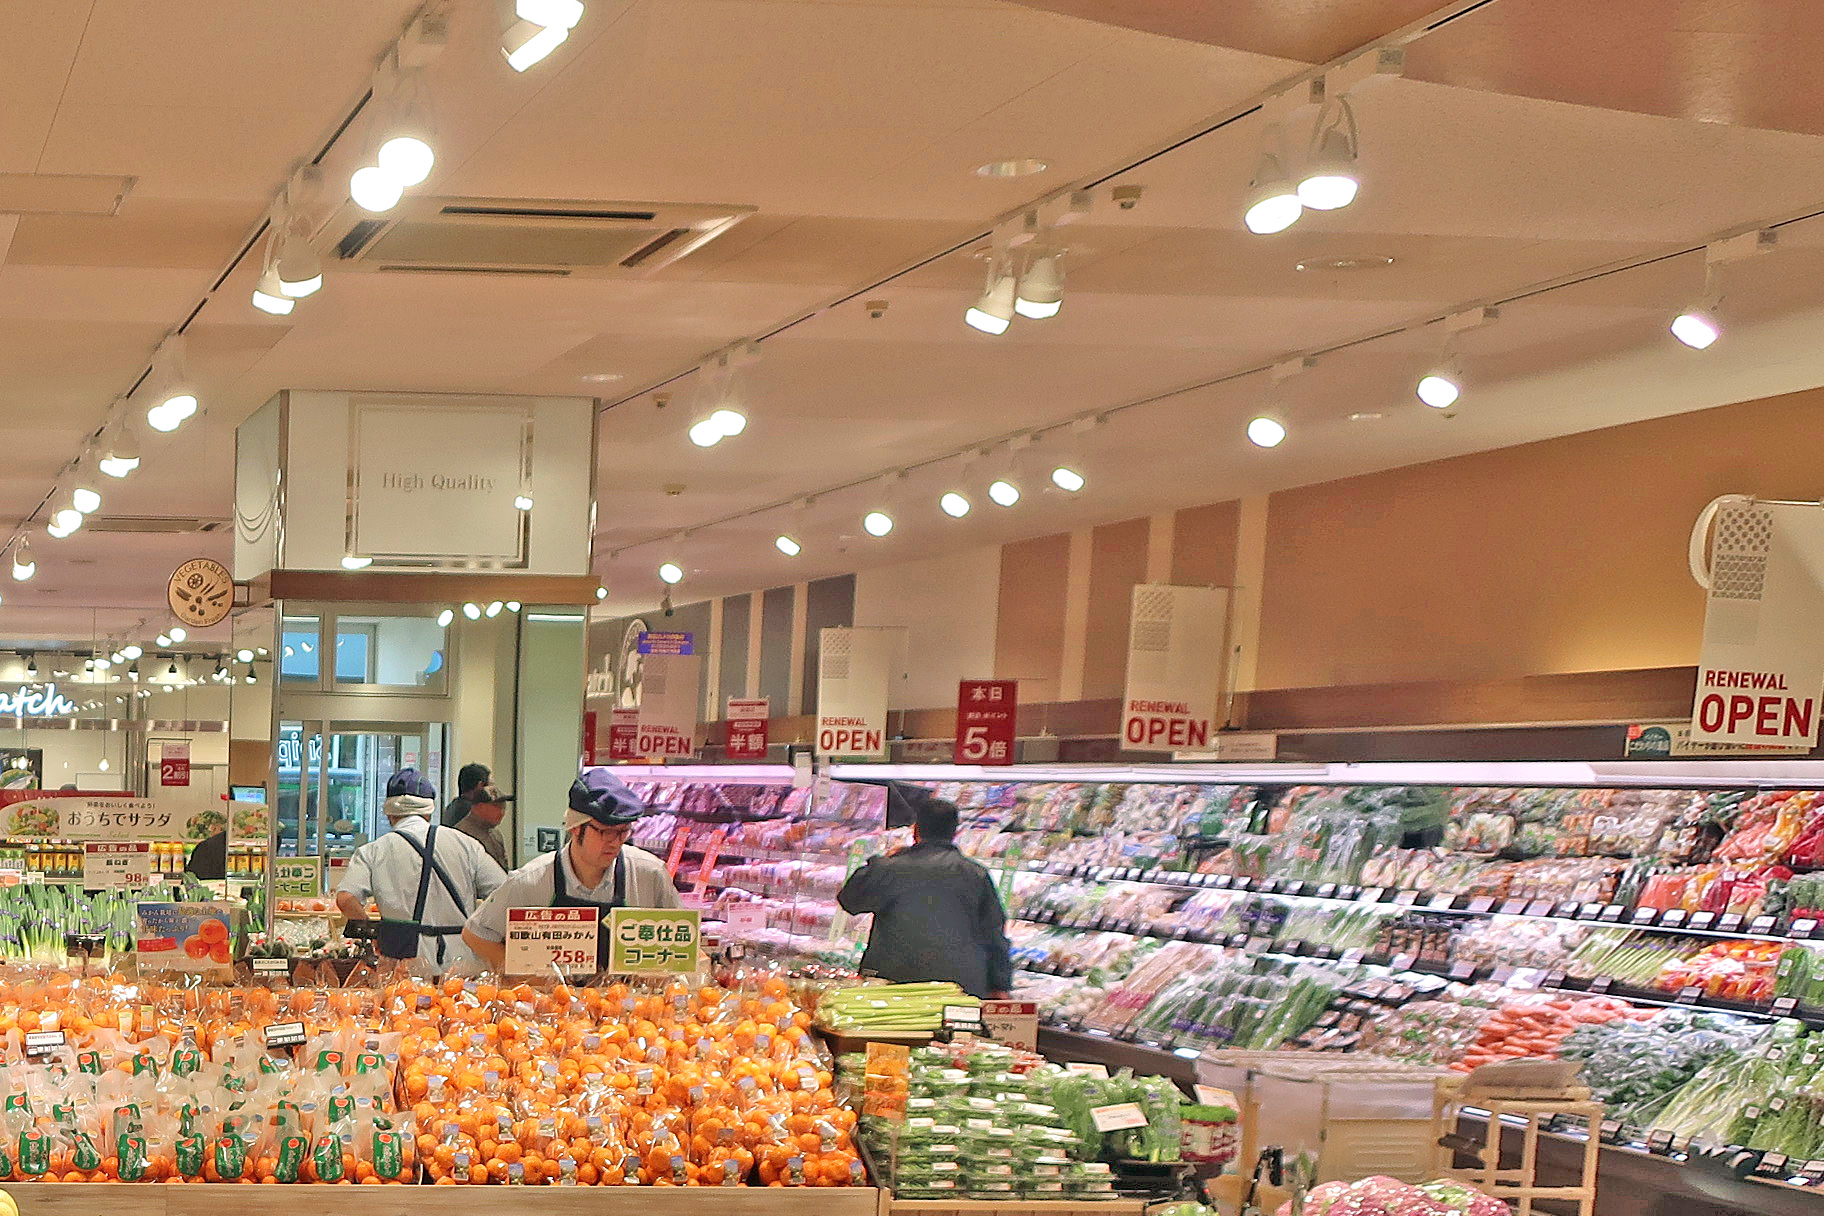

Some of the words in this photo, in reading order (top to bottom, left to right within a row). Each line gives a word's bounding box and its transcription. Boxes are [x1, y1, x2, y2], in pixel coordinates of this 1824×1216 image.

[382, 472, 424, 493] High
[431, 473, 497, 494] Quality
[174, 561, 229, 583] VEGETABLES
[1704, 670, 1788, 690] RENEWAL
[972, 687, 1004, 701] 本日
[1131, 701, 1190, 714] RENEWAL
[1699, 693, 1813, 737] OPEN
[822, 717, 867, 726] RENEWAL
[820, 730, 882, 751] OPEN
[1127, 717, 1208, 746] OPEN
[640, 735, 692, 754] OPEN
[963, 727, 1008, 760] 5倍
[67, 811, 172, 827] おうちでサラダ
[525, 910, 581, 920] 広告の品
[510, 930, 595, 940] 和歌山有田みかん
[621, 923, 691, 942] ご奉仕品
[625, 947, 688, 965] コーナー
